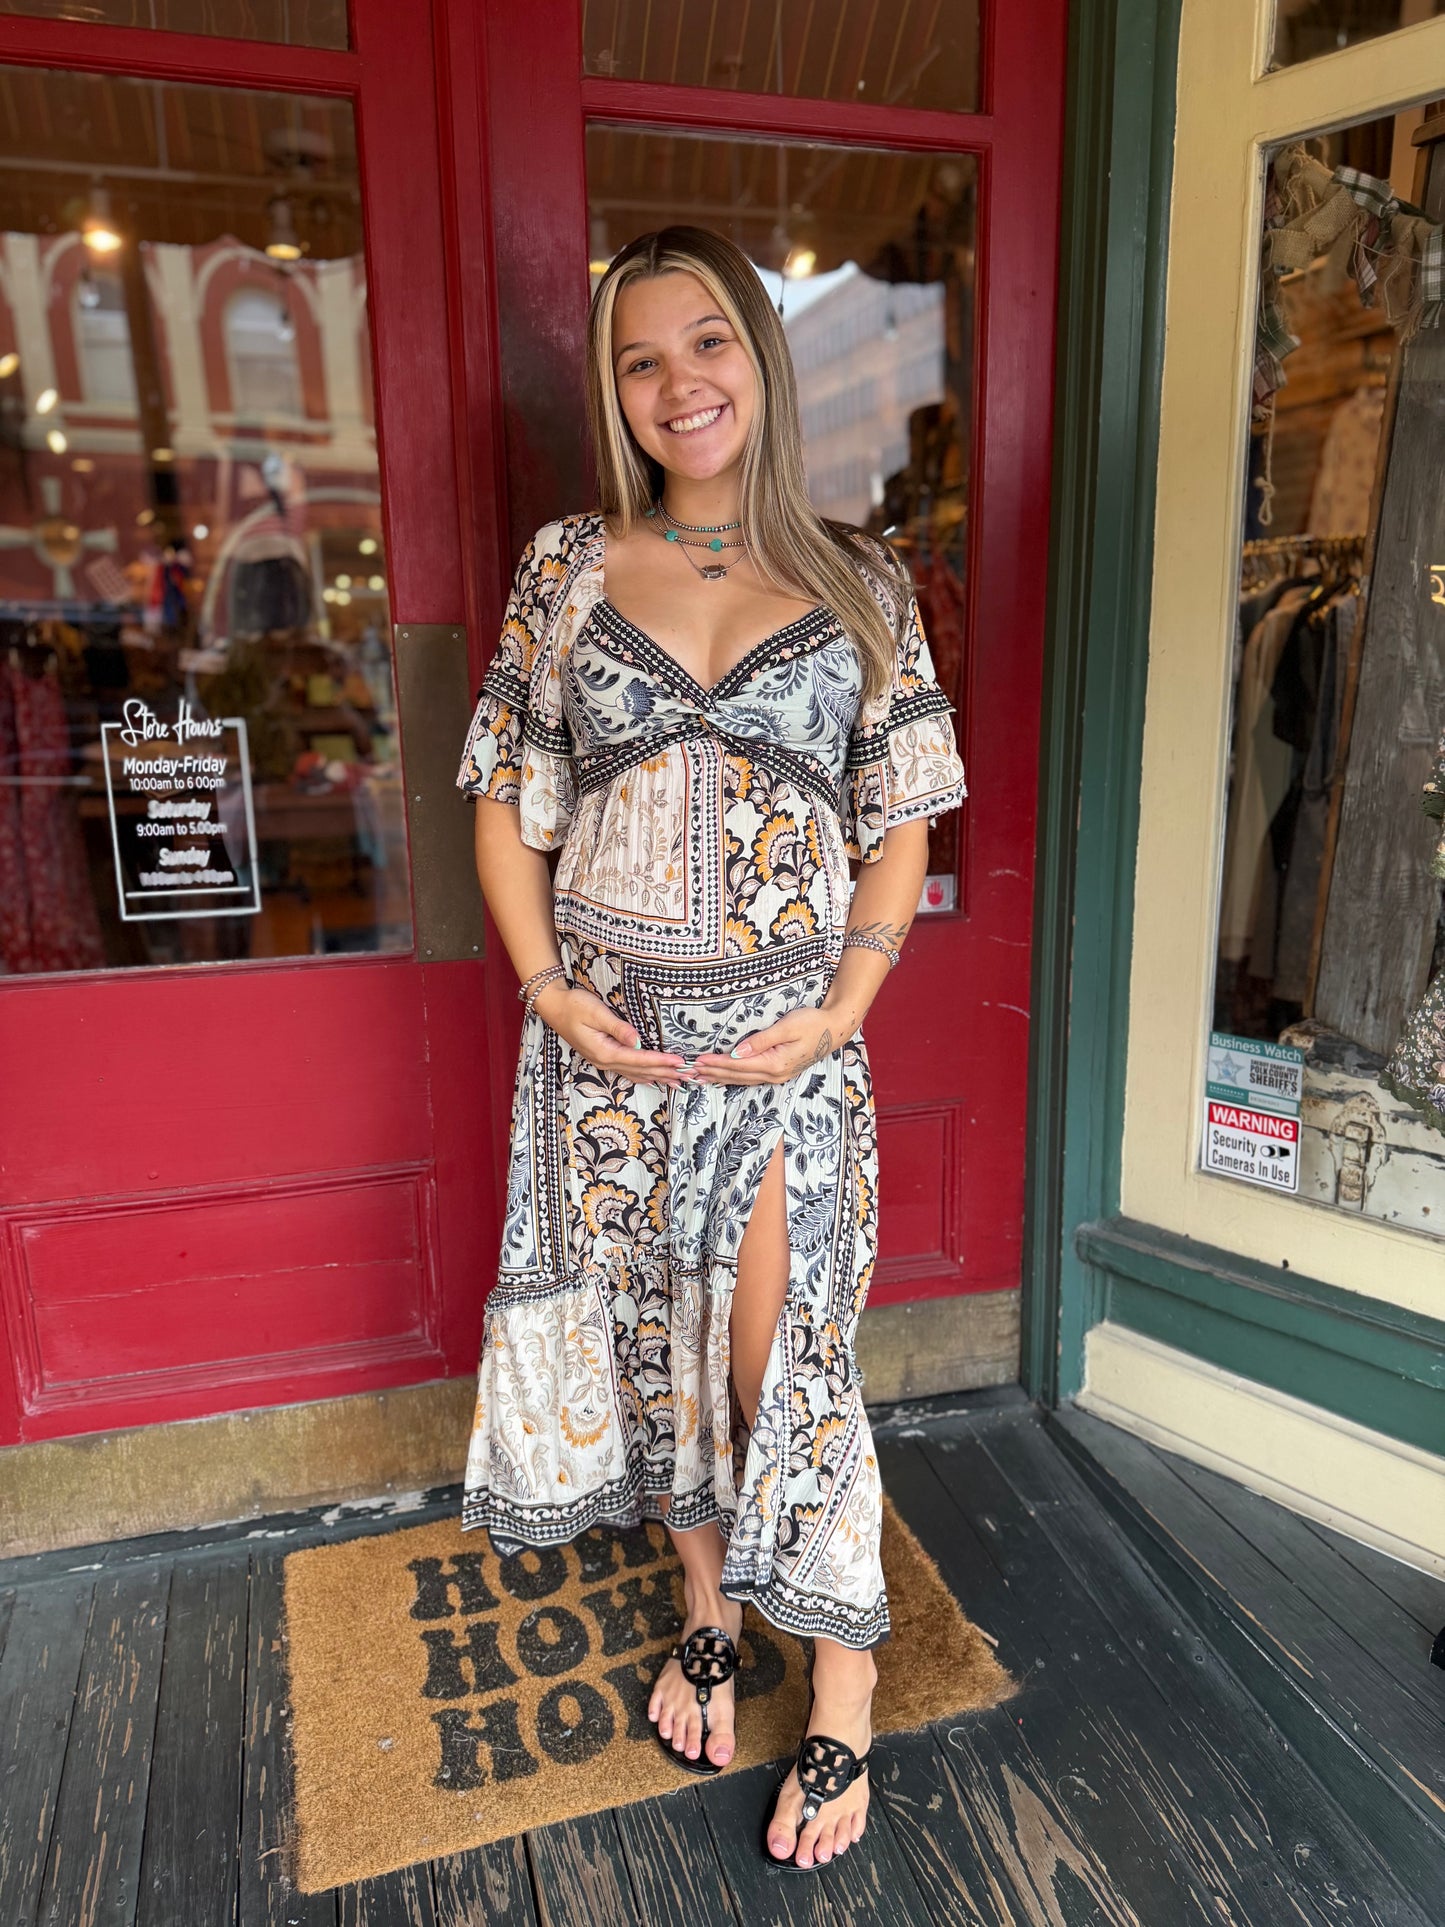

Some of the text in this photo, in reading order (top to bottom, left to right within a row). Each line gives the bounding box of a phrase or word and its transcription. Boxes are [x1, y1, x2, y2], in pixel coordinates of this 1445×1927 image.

[120, 697, 223, 746] Store Hours
[123, 756, 227, 776] Monday-Friday
[129, 776, 225, 791] 10:00am to 600pm
[136, 823, 175, 837] 9:00am
[176, 822, 188, 836] to
[1212, 1034, 1301, 1062] Business Watch
[1250, 1065, 1268, 1076] POLK
[1269, 1069, 1298, 1081] COUNTY
[1212, 1105, 1294, 1139] WARNING
[1213, 1130, 1257, 1158] Security
[1212, 1149, 1290, 1184] Cameras In Use
